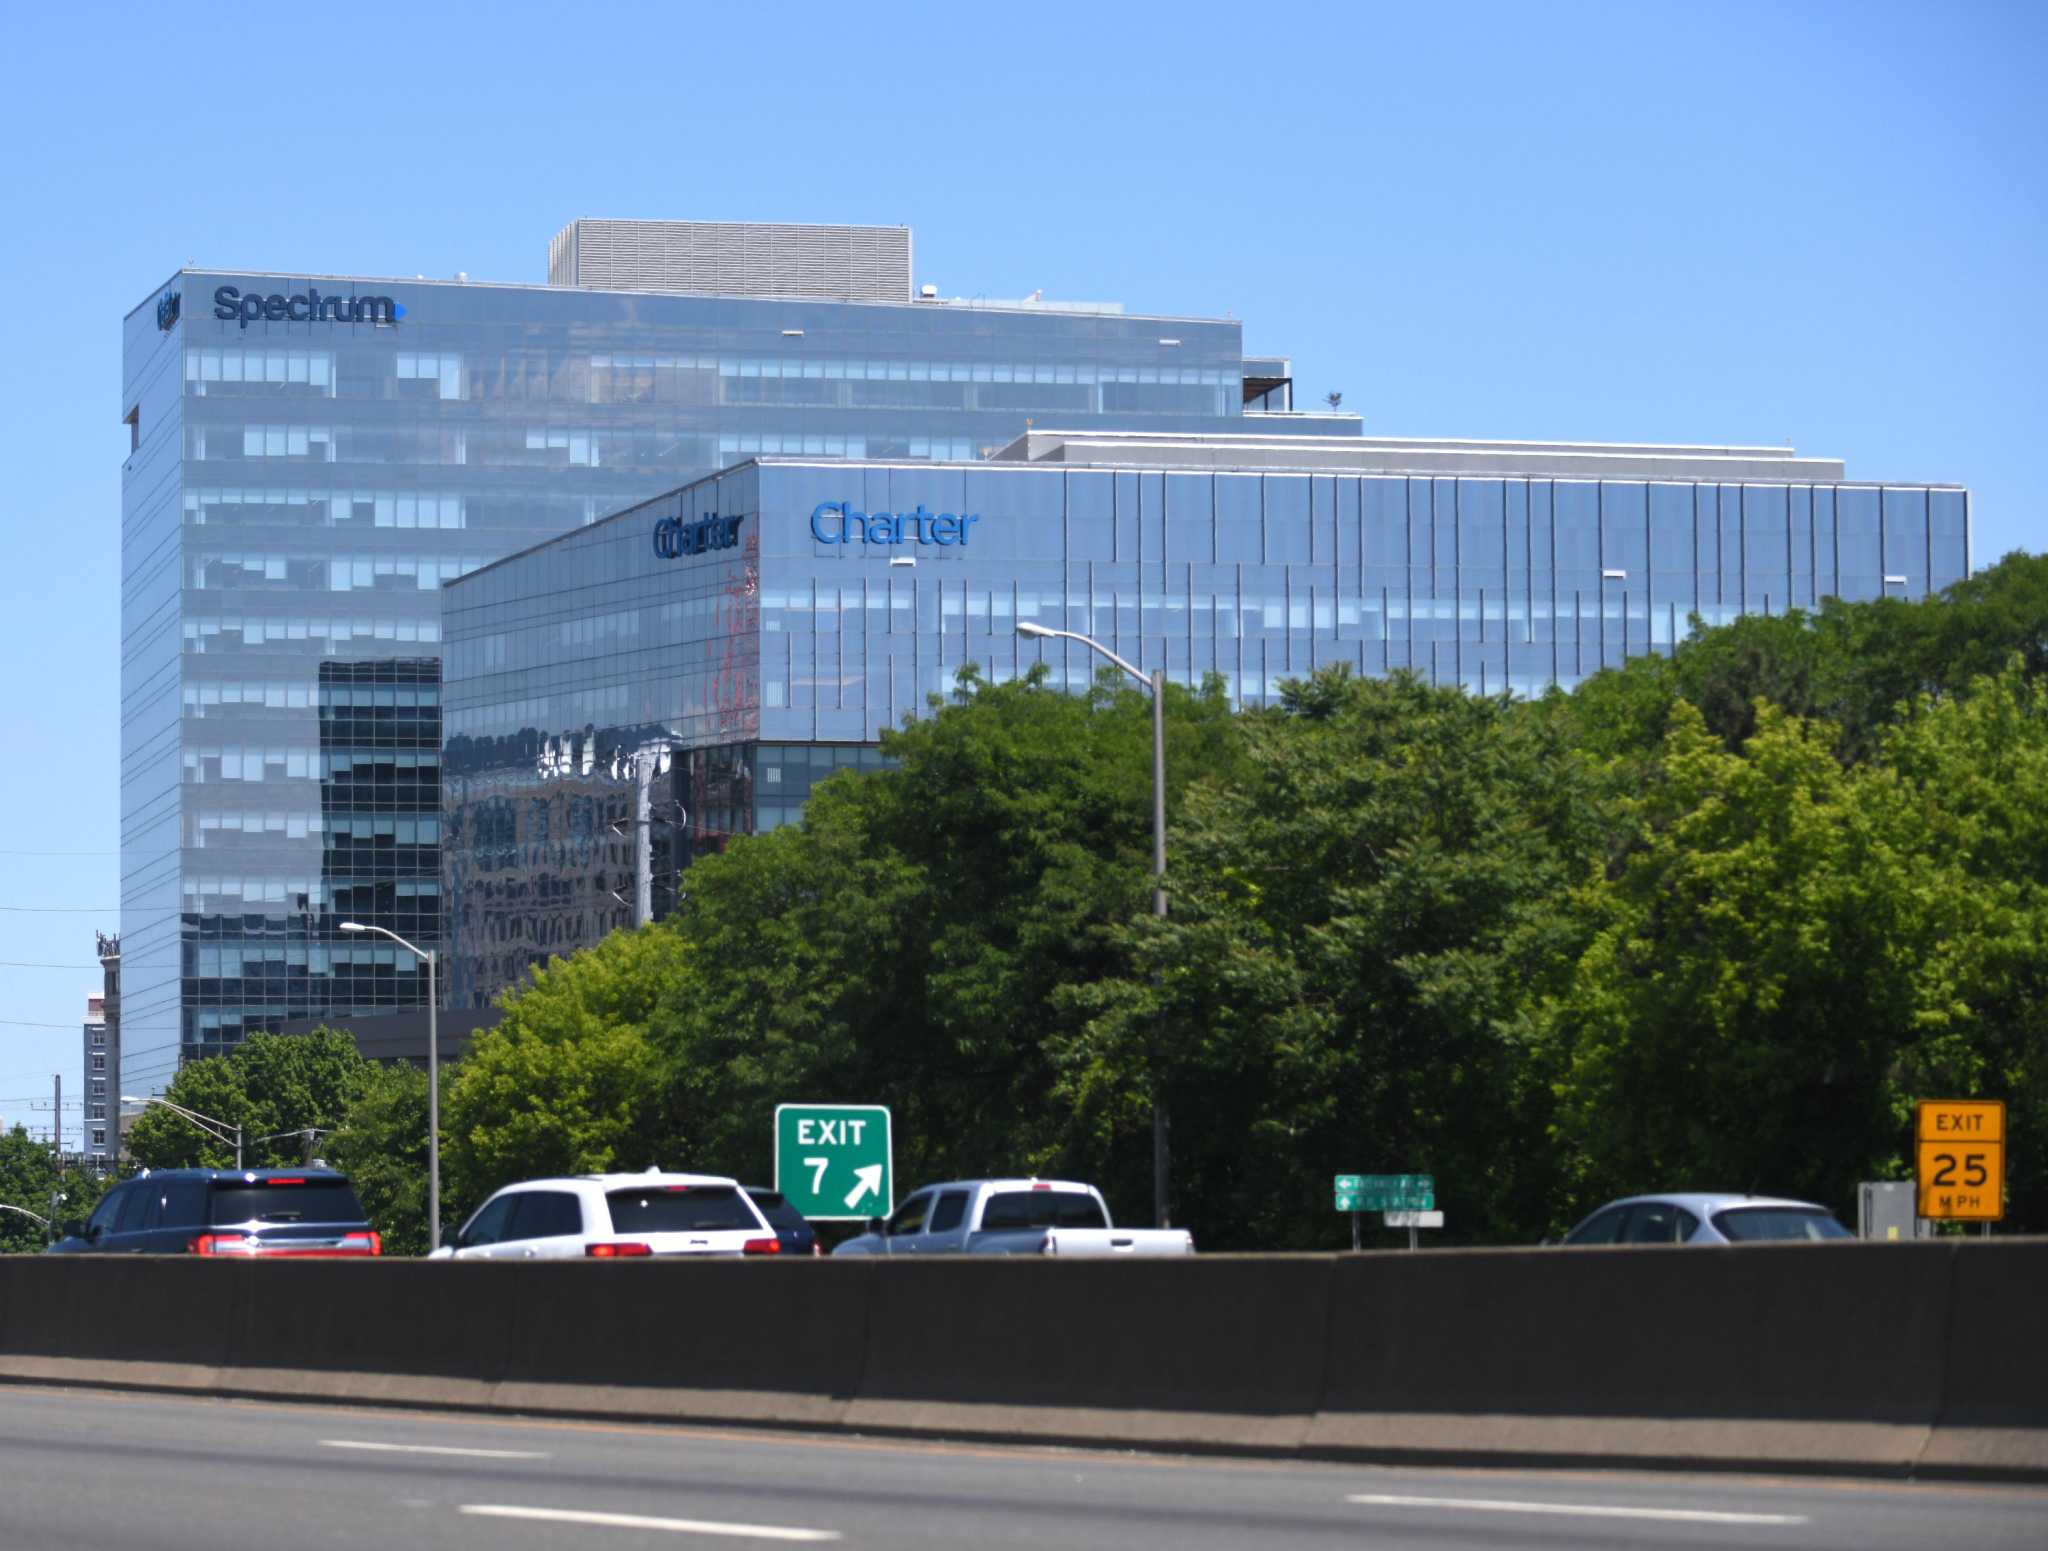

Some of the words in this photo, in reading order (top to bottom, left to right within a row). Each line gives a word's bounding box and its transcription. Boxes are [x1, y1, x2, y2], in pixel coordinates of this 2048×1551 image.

[214, 285, 395, 329] Spectrum
[653, 512, 744, 559] Charter
[811, 501, 979, 545] Charter
[797, 1119, 867, 1145] EXIT
[1936, 1114, 1984, 1131] EXIT
[803, 1157, 829, 1194] 7
[1933, 1153, 1987, 1187] 25
[1939, 1195, 1981, 1209] MPH
